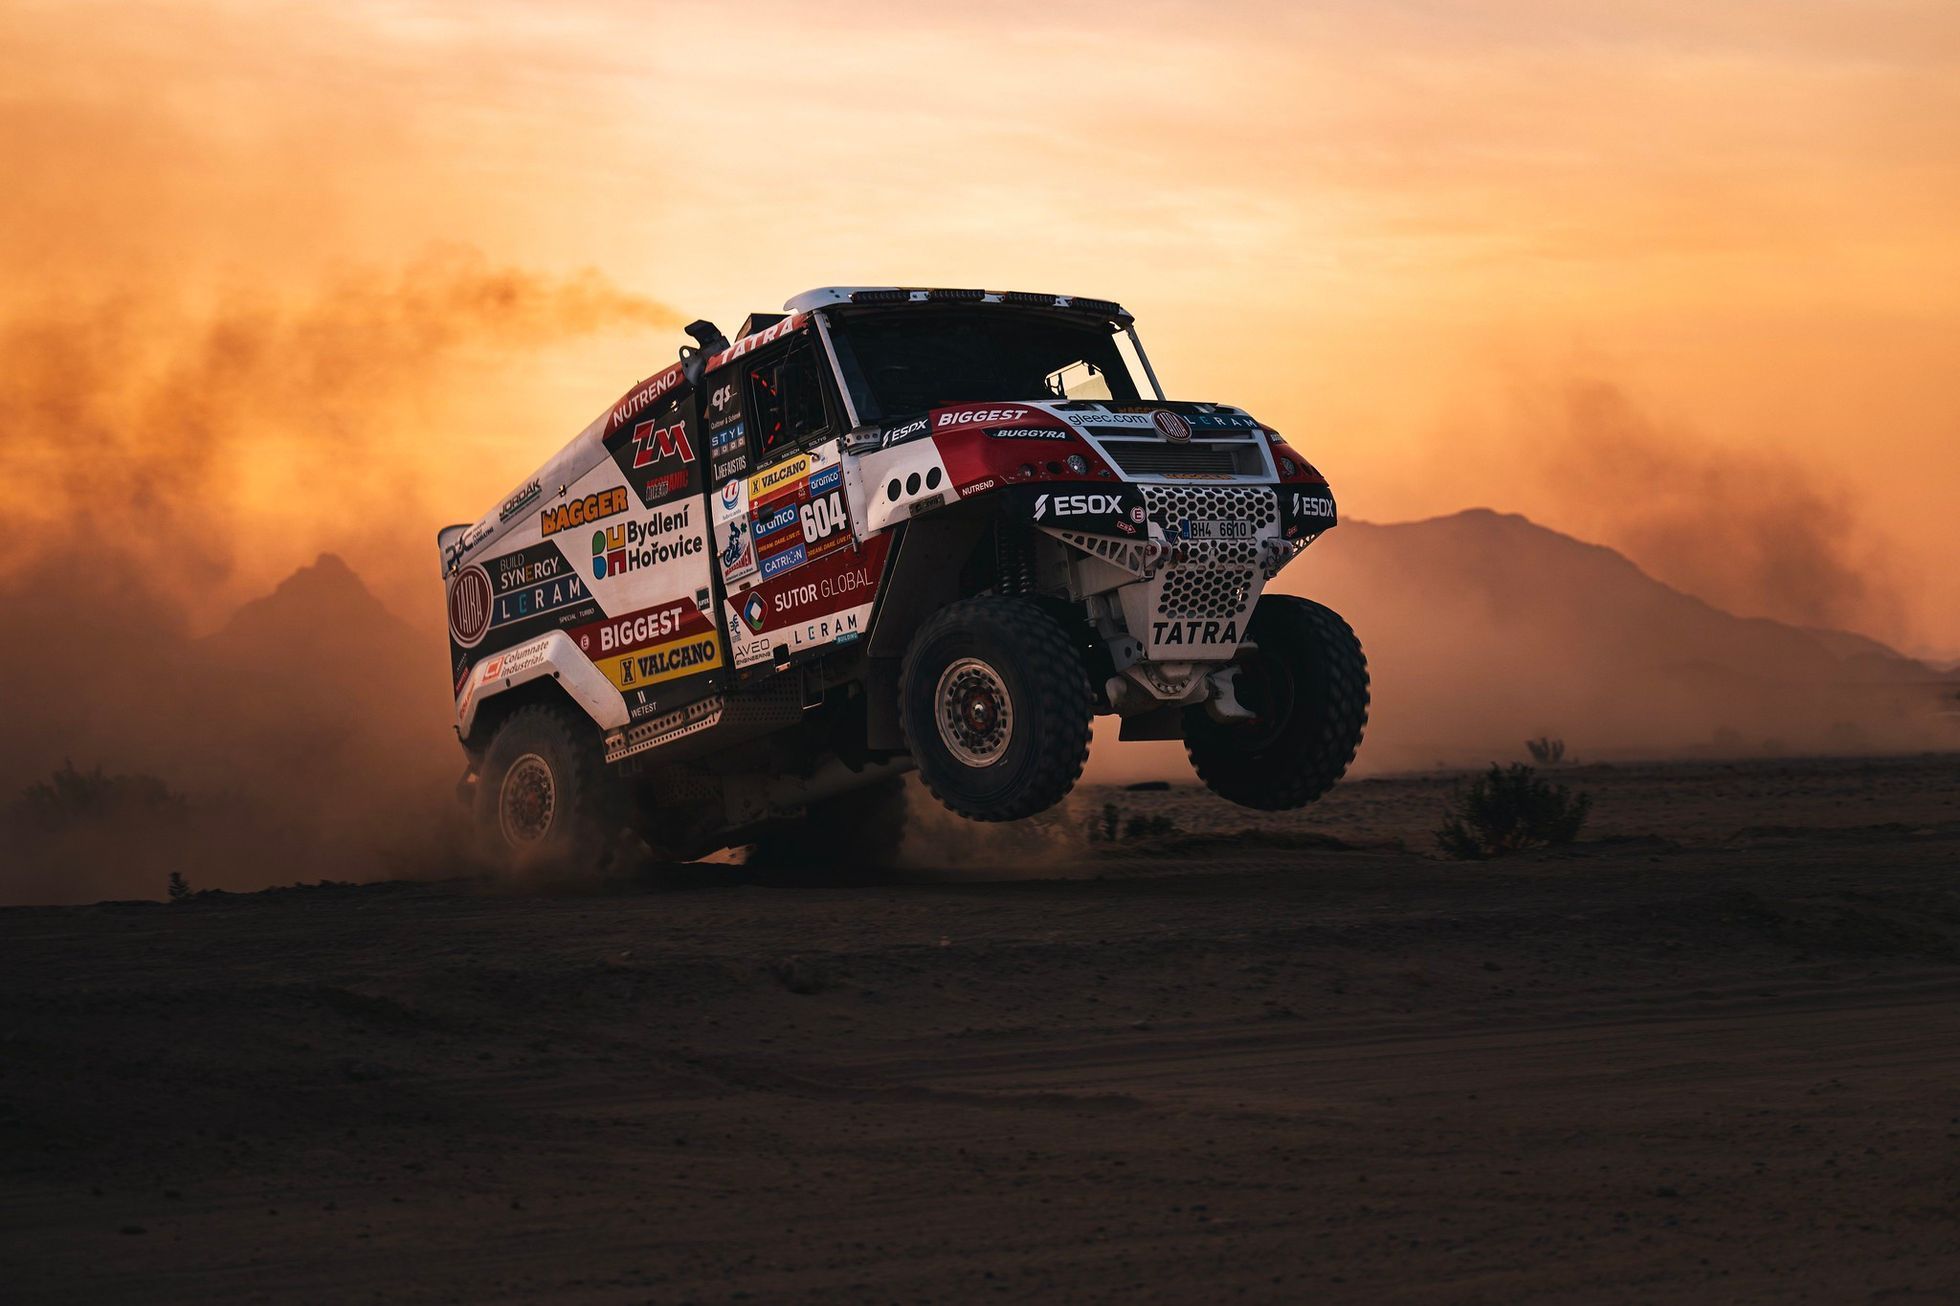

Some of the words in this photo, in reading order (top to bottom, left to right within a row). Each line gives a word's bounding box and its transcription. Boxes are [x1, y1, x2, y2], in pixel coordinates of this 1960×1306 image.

[719, 318, 794, 365] TATRA
[613, 370, 677, 428] NUTREND
[938, 409, 1028, 427] BIGGEST
[1068, 412, 1147, 426] gleec.com
[1156, 413, 1188, 438] TATRA
[711, 427, 744, 447] STYL
[892, 419, 929, 442] ESOX
[997, 429, 1066, 439] BUGGYRA
[761, 459, 806, 488] VALCANO
[811, 472, 839, 489] aramco
[962, 479, 995, 496] NUTREND
[541, 485, 629, 538] BAGGER
[800, 491, 847, 544] 604
[1053, 495, 1124, 516] ESOX
[1302, 496, 1335, 518] ESOX
[628, 503, 689, 544] Bydlení
[756, 509, 795, 534] aramco
[1219, 522, 1247, 537] 6610
[500, 552, 524, 571] BUILD
[629, 534, 703, 572] Hořovice
[501, 556, 560, 590] SYNERGY
[774, 583, 818, 612] SUTOR
[820, 568, 874, 598] GLOBAL
[454, 571, 483, 634] TATRA
[600, 607, 683, 652] BIGGEST
[1153, 621, 1238, 645] TATRA
[637, 640, 716, 678] VALCANO
[735, 638, 770, 660] AVEO
[631, 702, 658, 718] WETEST
